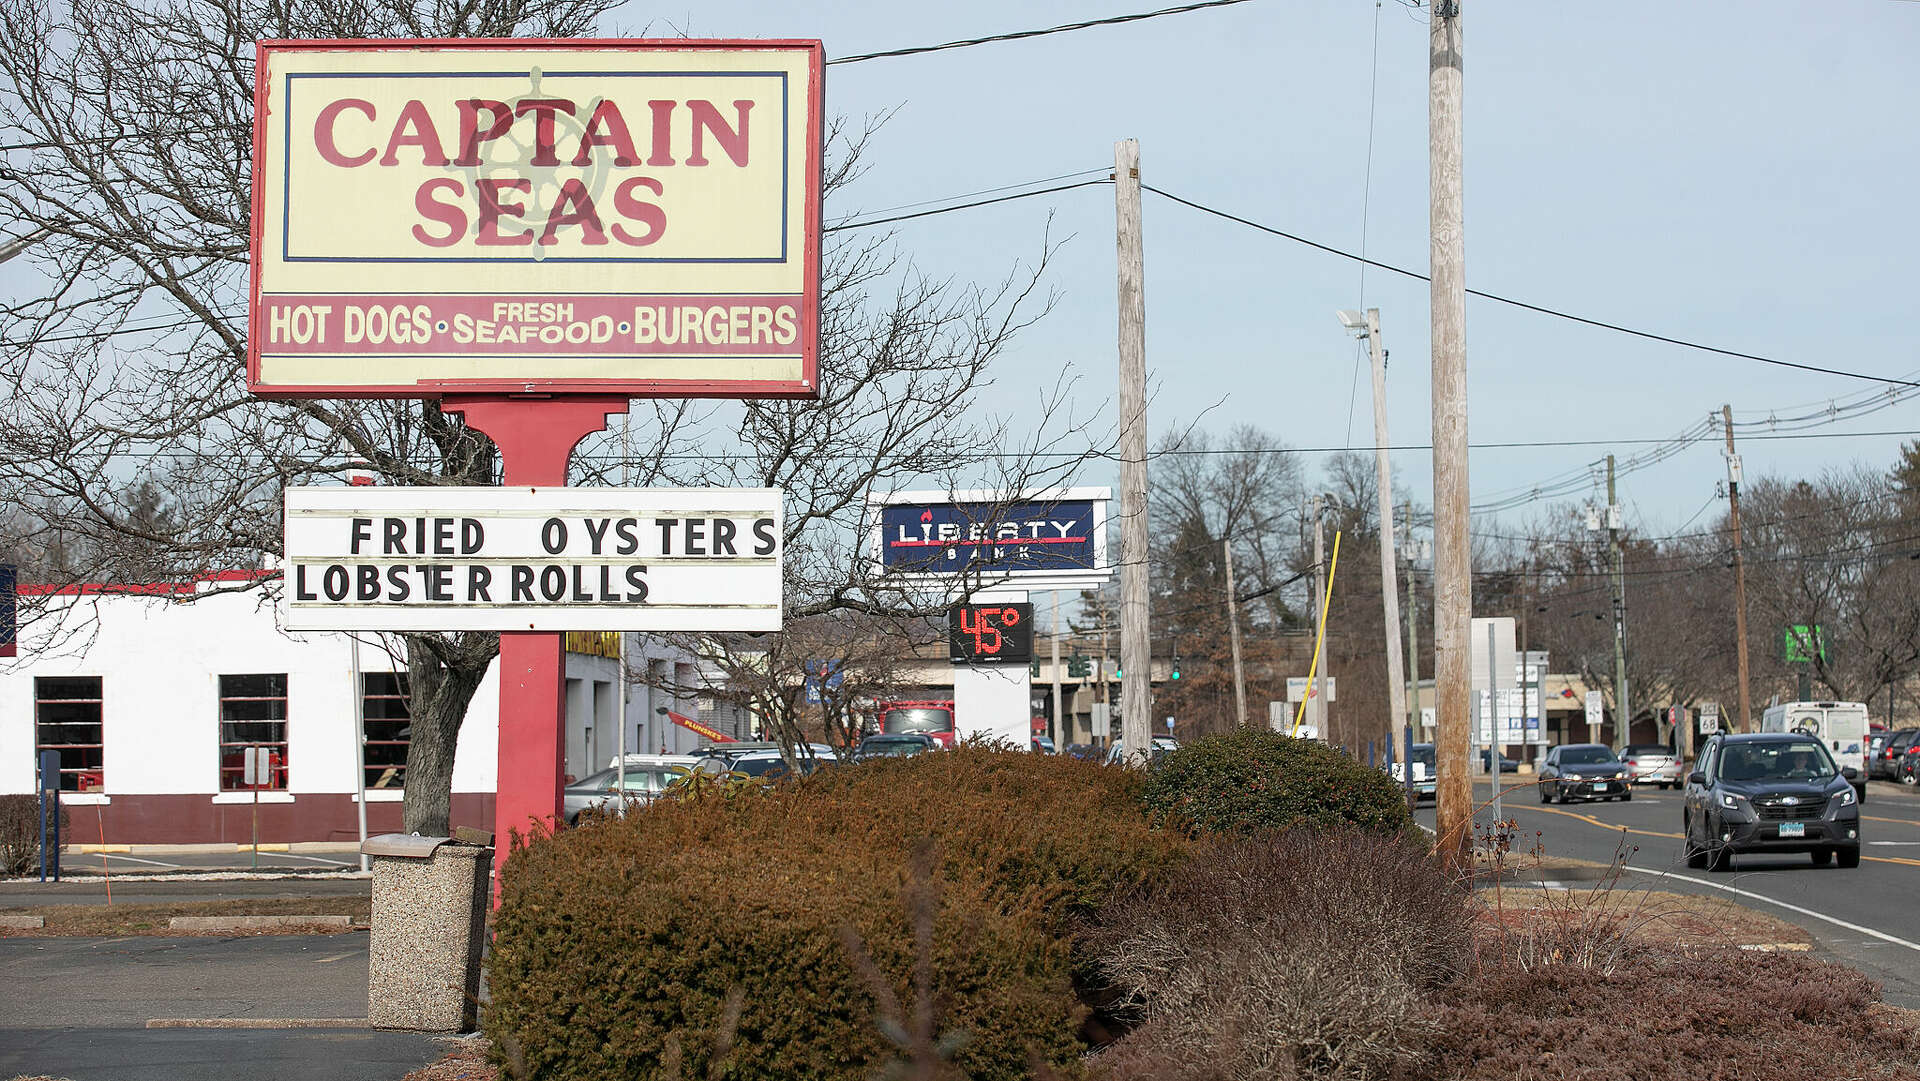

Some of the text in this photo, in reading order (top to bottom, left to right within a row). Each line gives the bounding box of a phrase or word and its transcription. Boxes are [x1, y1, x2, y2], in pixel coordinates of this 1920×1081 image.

[314, 99, 755, 167] CAPTAIN
[411, 176, 667, 247] SEAS
[269, 304, 797, 345] HOT DOGS SEAFOOD BURGERS
[492, 302, 574, 320] FRESH
[350, 517, 776, 556] FRIED OYSTERS
[899, 520, 1077, 545] LIBERTY
[296, 564, 649, 602] LOBSTER ROLLS
[1702, 718, 1716, 730] 68
